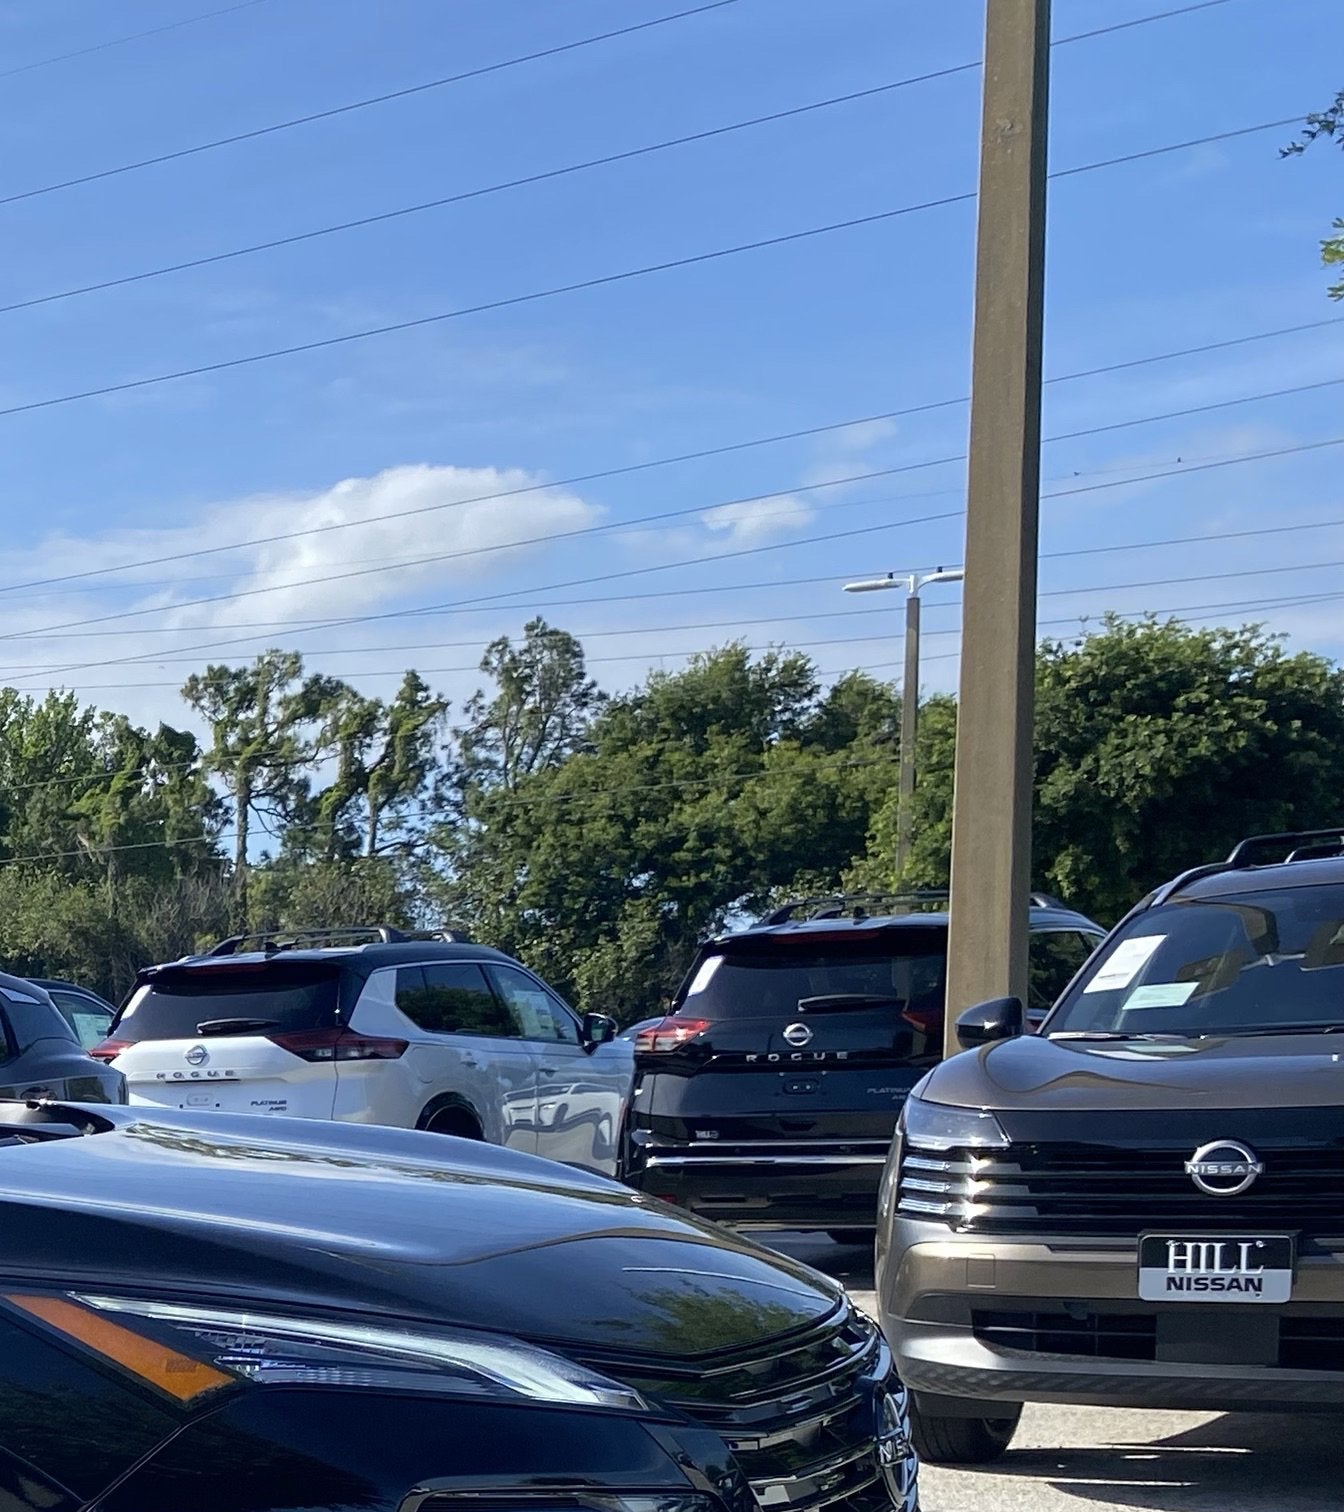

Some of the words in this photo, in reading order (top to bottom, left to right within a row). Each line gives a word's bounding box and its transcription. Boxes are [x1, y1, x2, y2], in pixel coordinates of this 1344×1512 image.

[746, 1051, 848, 1063] ROGUE
[1187, 1164, 1261, 1175] NISSAN
[1165, 1240, 1265, 1275] HILL
[1166, 1276, 1263, 1293] NISSAN
